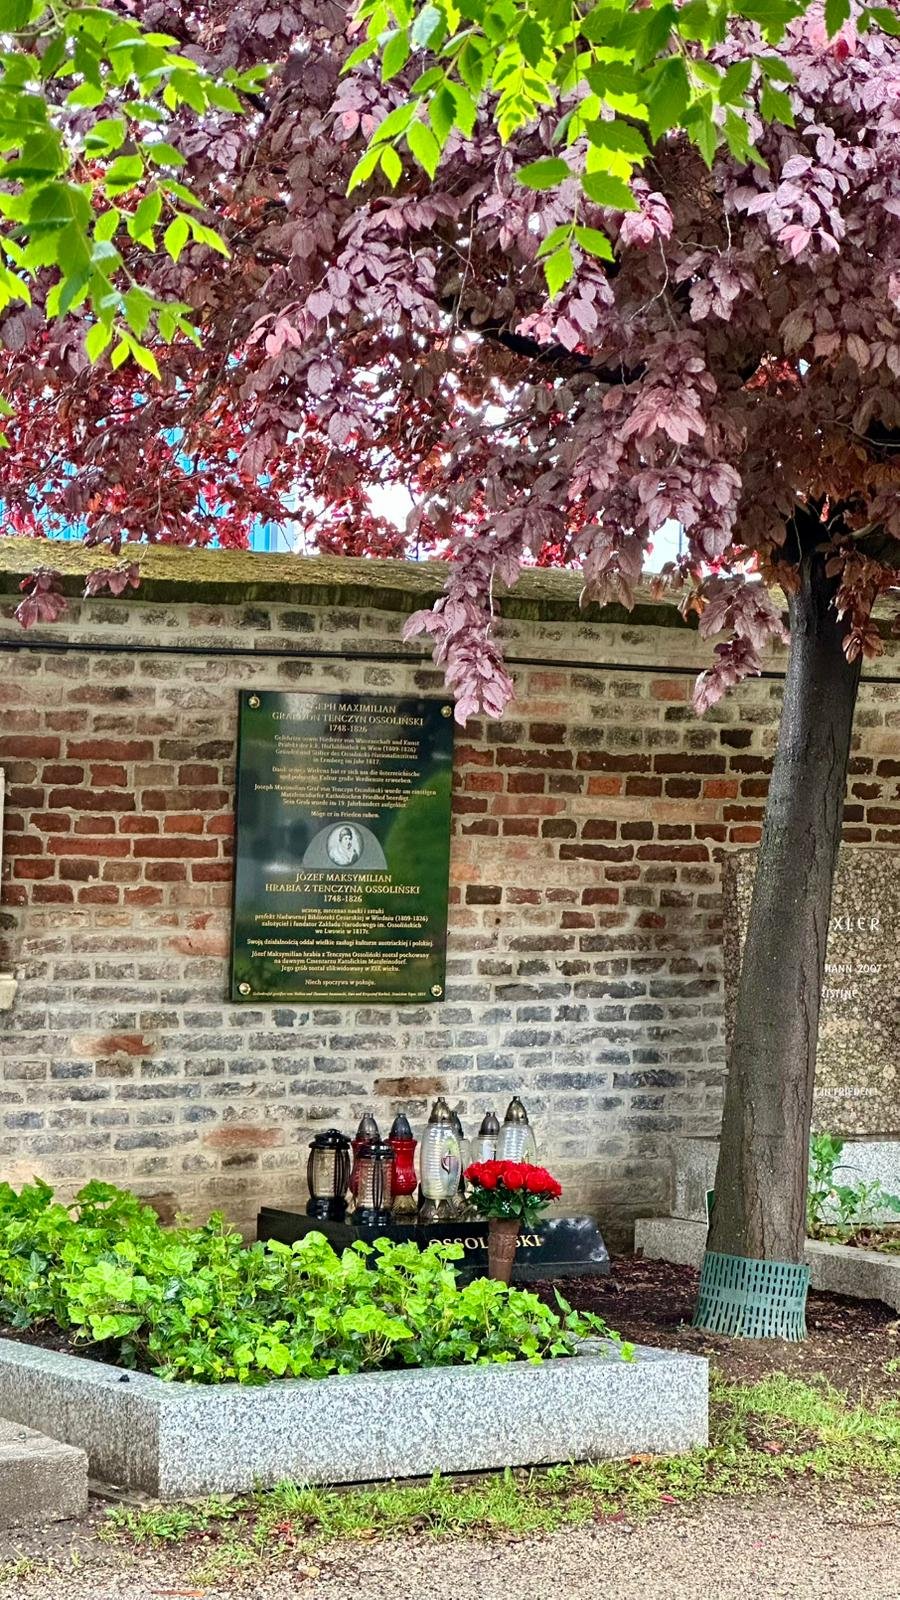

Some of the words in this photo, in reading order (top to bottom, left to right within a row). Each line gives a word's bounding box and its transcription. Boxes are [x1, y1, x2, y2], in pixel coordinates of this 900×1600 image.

[339, 703, 396, 713] MAXIMILIAN
[323, 714, 367, 724] TENCZYN
[368, 714, 424, 726] OSSOLIŃSKI
[329, 724, 368, 733] 1748-1826
[254, 783, 274, 791] Joseph
[295, 871, 324, 882] JÓZEF
[326, 873, 392, 883] MAKSYMILIAN
[265, 883, 302, 892] HRABIA
[303, 884, 311, 892] Z
[312, 884, 363, 893] TENCZYNA
[365, 883, 421, 894] OSSOLIŃSKI
[324, 894, 363, 903] 1748-1826
[255, 913, 275, 921] prefekt
[276, 913, 307, 921] Nadwornej
[341, 921, 376, 929] Narodowego
[322, 979, 348, 987] spoczywa
